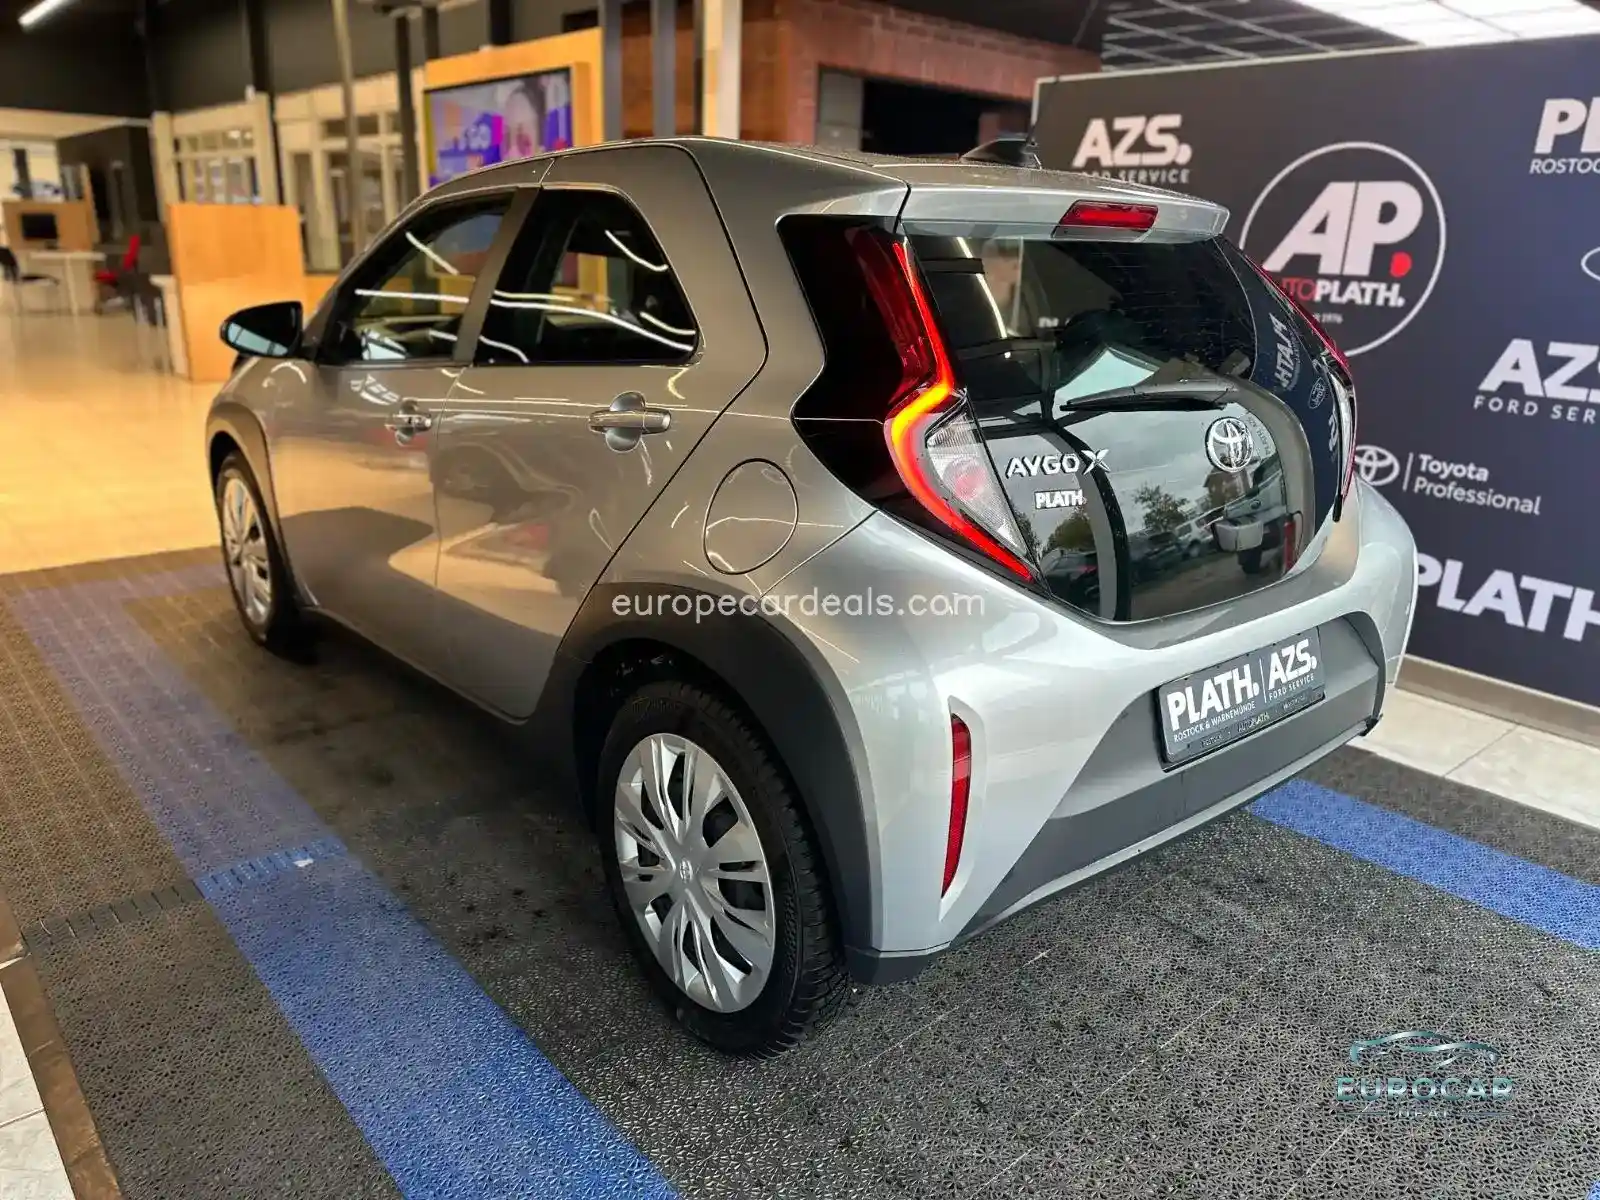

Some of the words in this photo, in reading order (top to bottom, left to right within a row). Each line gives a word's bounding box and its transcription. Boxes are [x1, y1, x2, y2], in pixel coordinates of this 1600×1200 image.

[1072, 113, 1192, 168] AZS.
[1118, 168, 1191, 184] SERVICE
[1478, 338, 1600, 404] AZ
[1473, 395, 1539, 416] FORD
[1006, 453, 1081, 478] AYGO
[1419, 454, 1490, 482] Toyota
[1414, 476, 1541, 516] Professional
[1166, 663, 1260, 731] PLATH.
[1268, 639, 1318, 691] AZS.
[1269, 687, 1287, 701] FORD
[1288, 672, 1315, 692] SERVICE
[1173, 723, 1205, 743] ROSTOCK
